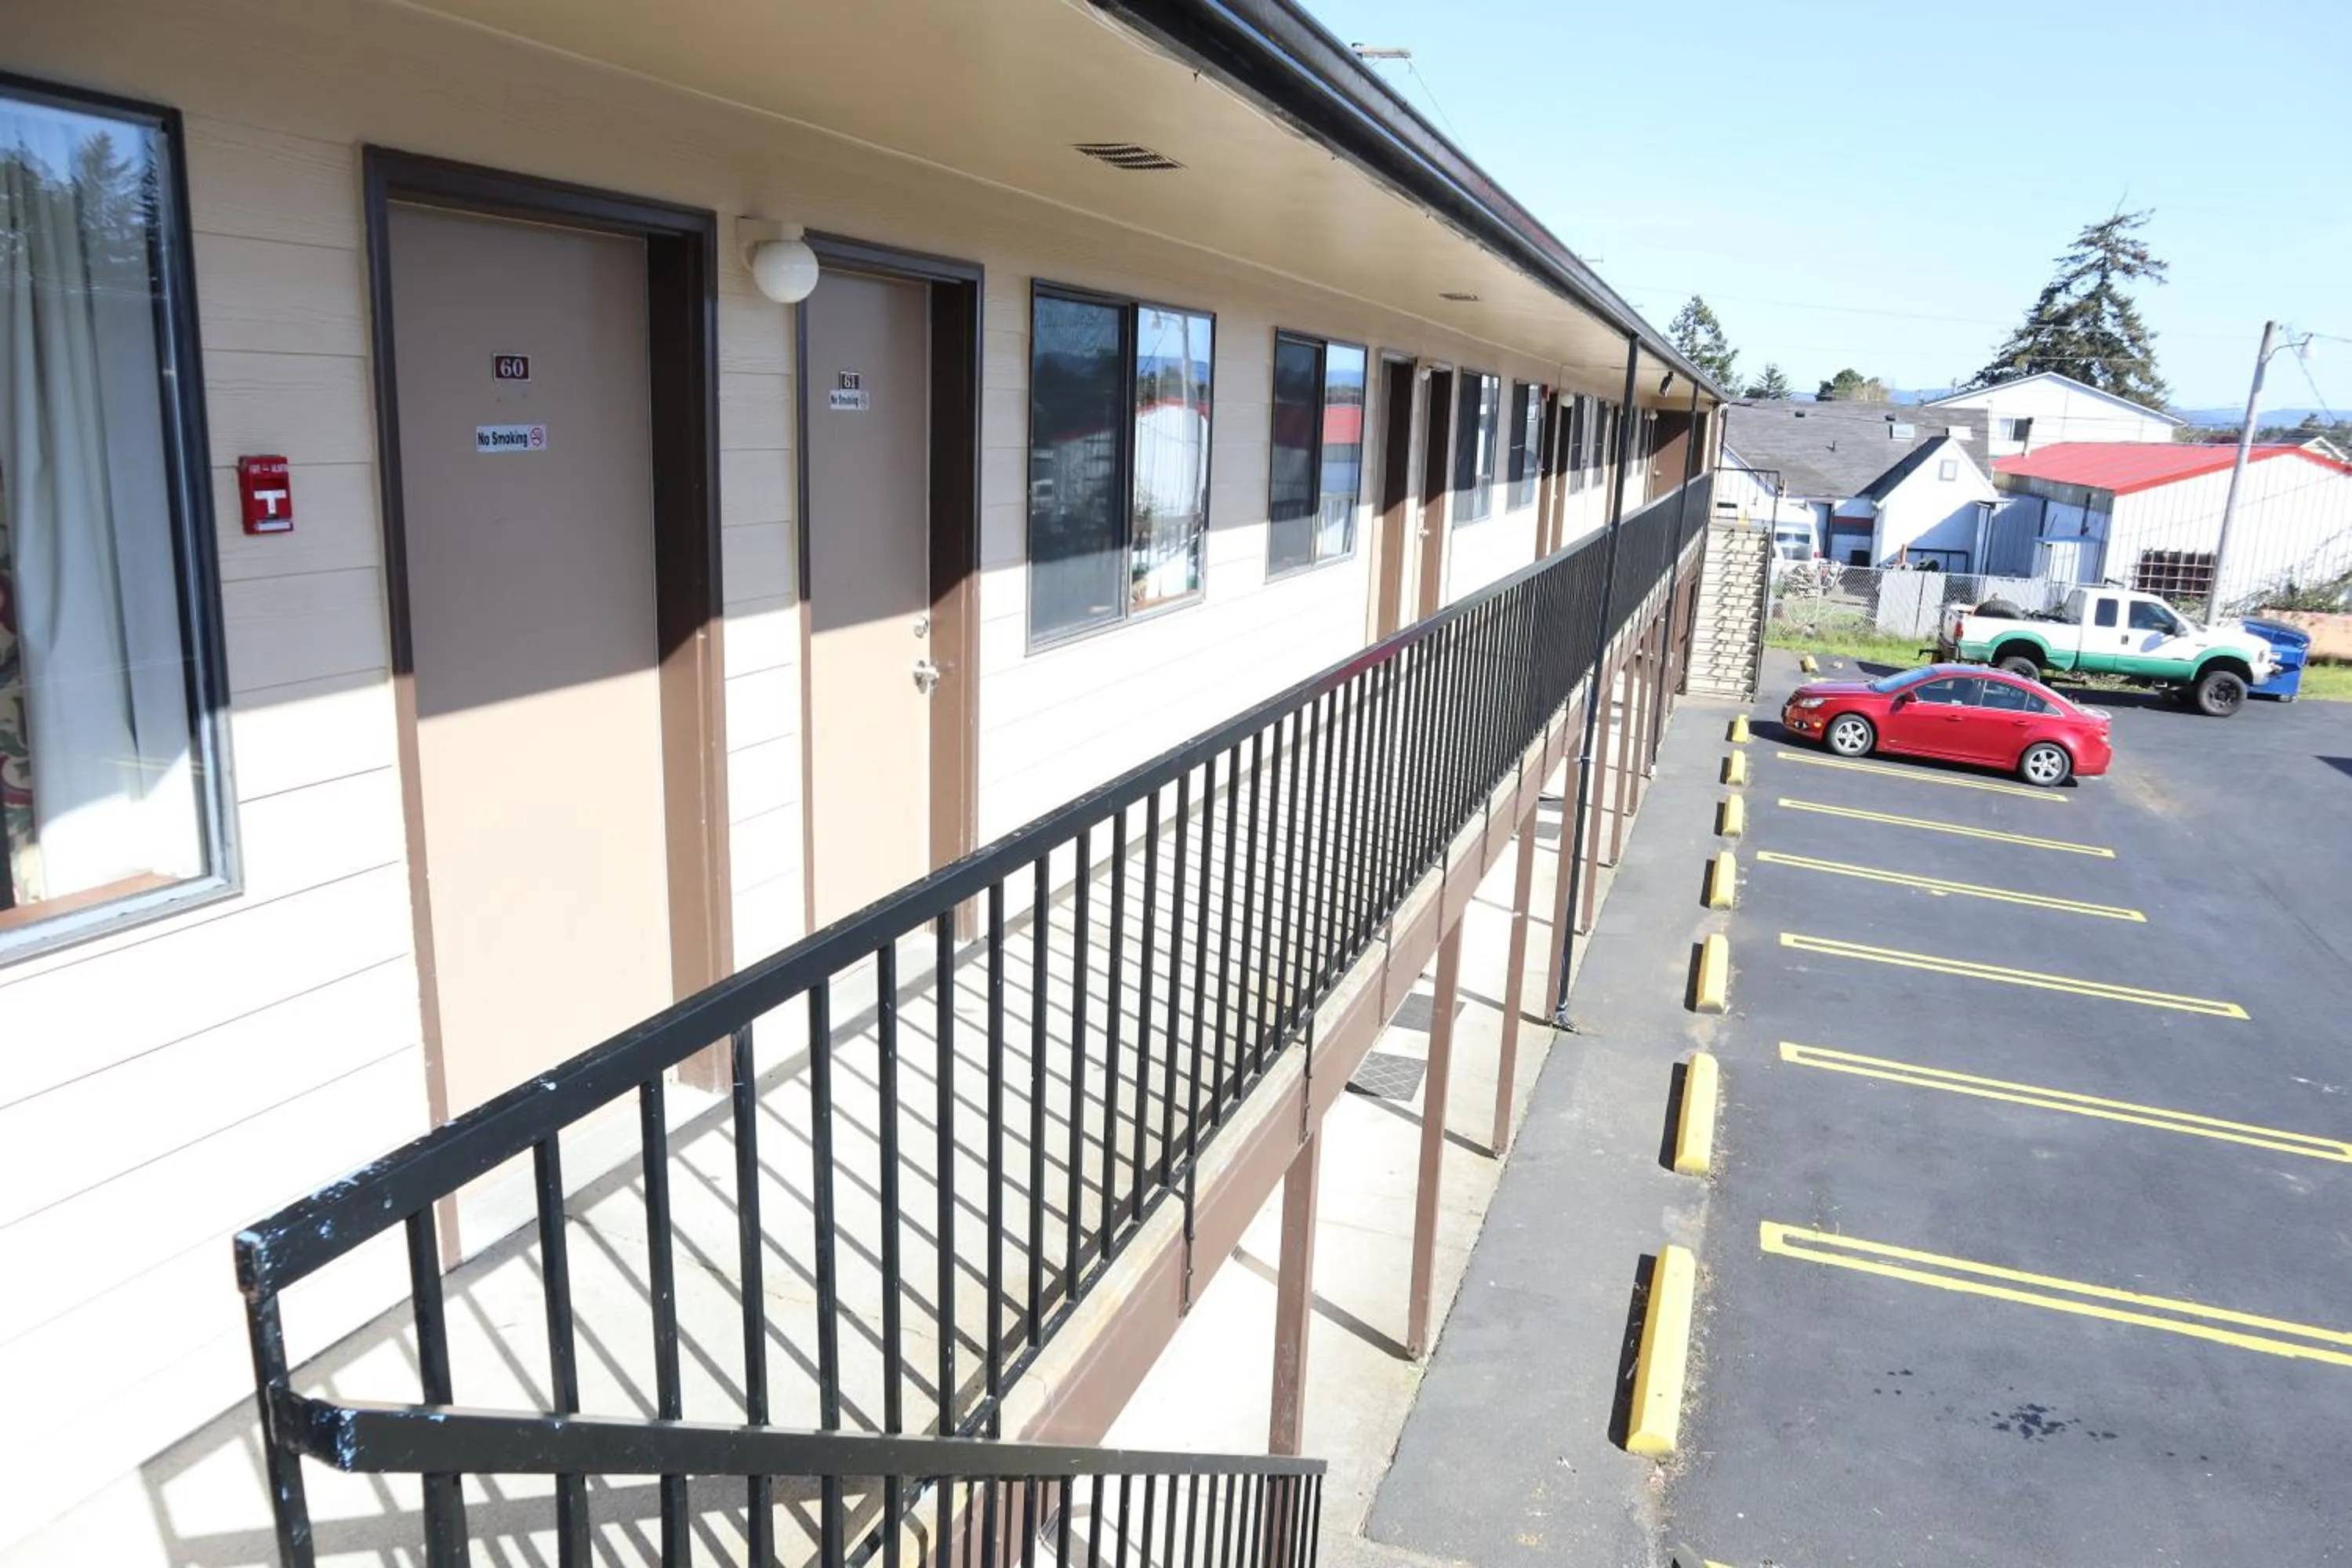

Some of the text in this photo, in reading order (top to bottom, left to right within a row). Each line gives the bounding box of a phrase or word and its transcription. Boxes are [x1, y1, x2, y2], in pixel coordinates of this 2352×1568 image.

[499, 358, 524, 377] 60
[844, 376, 855, 388] 61
[477, 430, 528, 448] No Smoking
